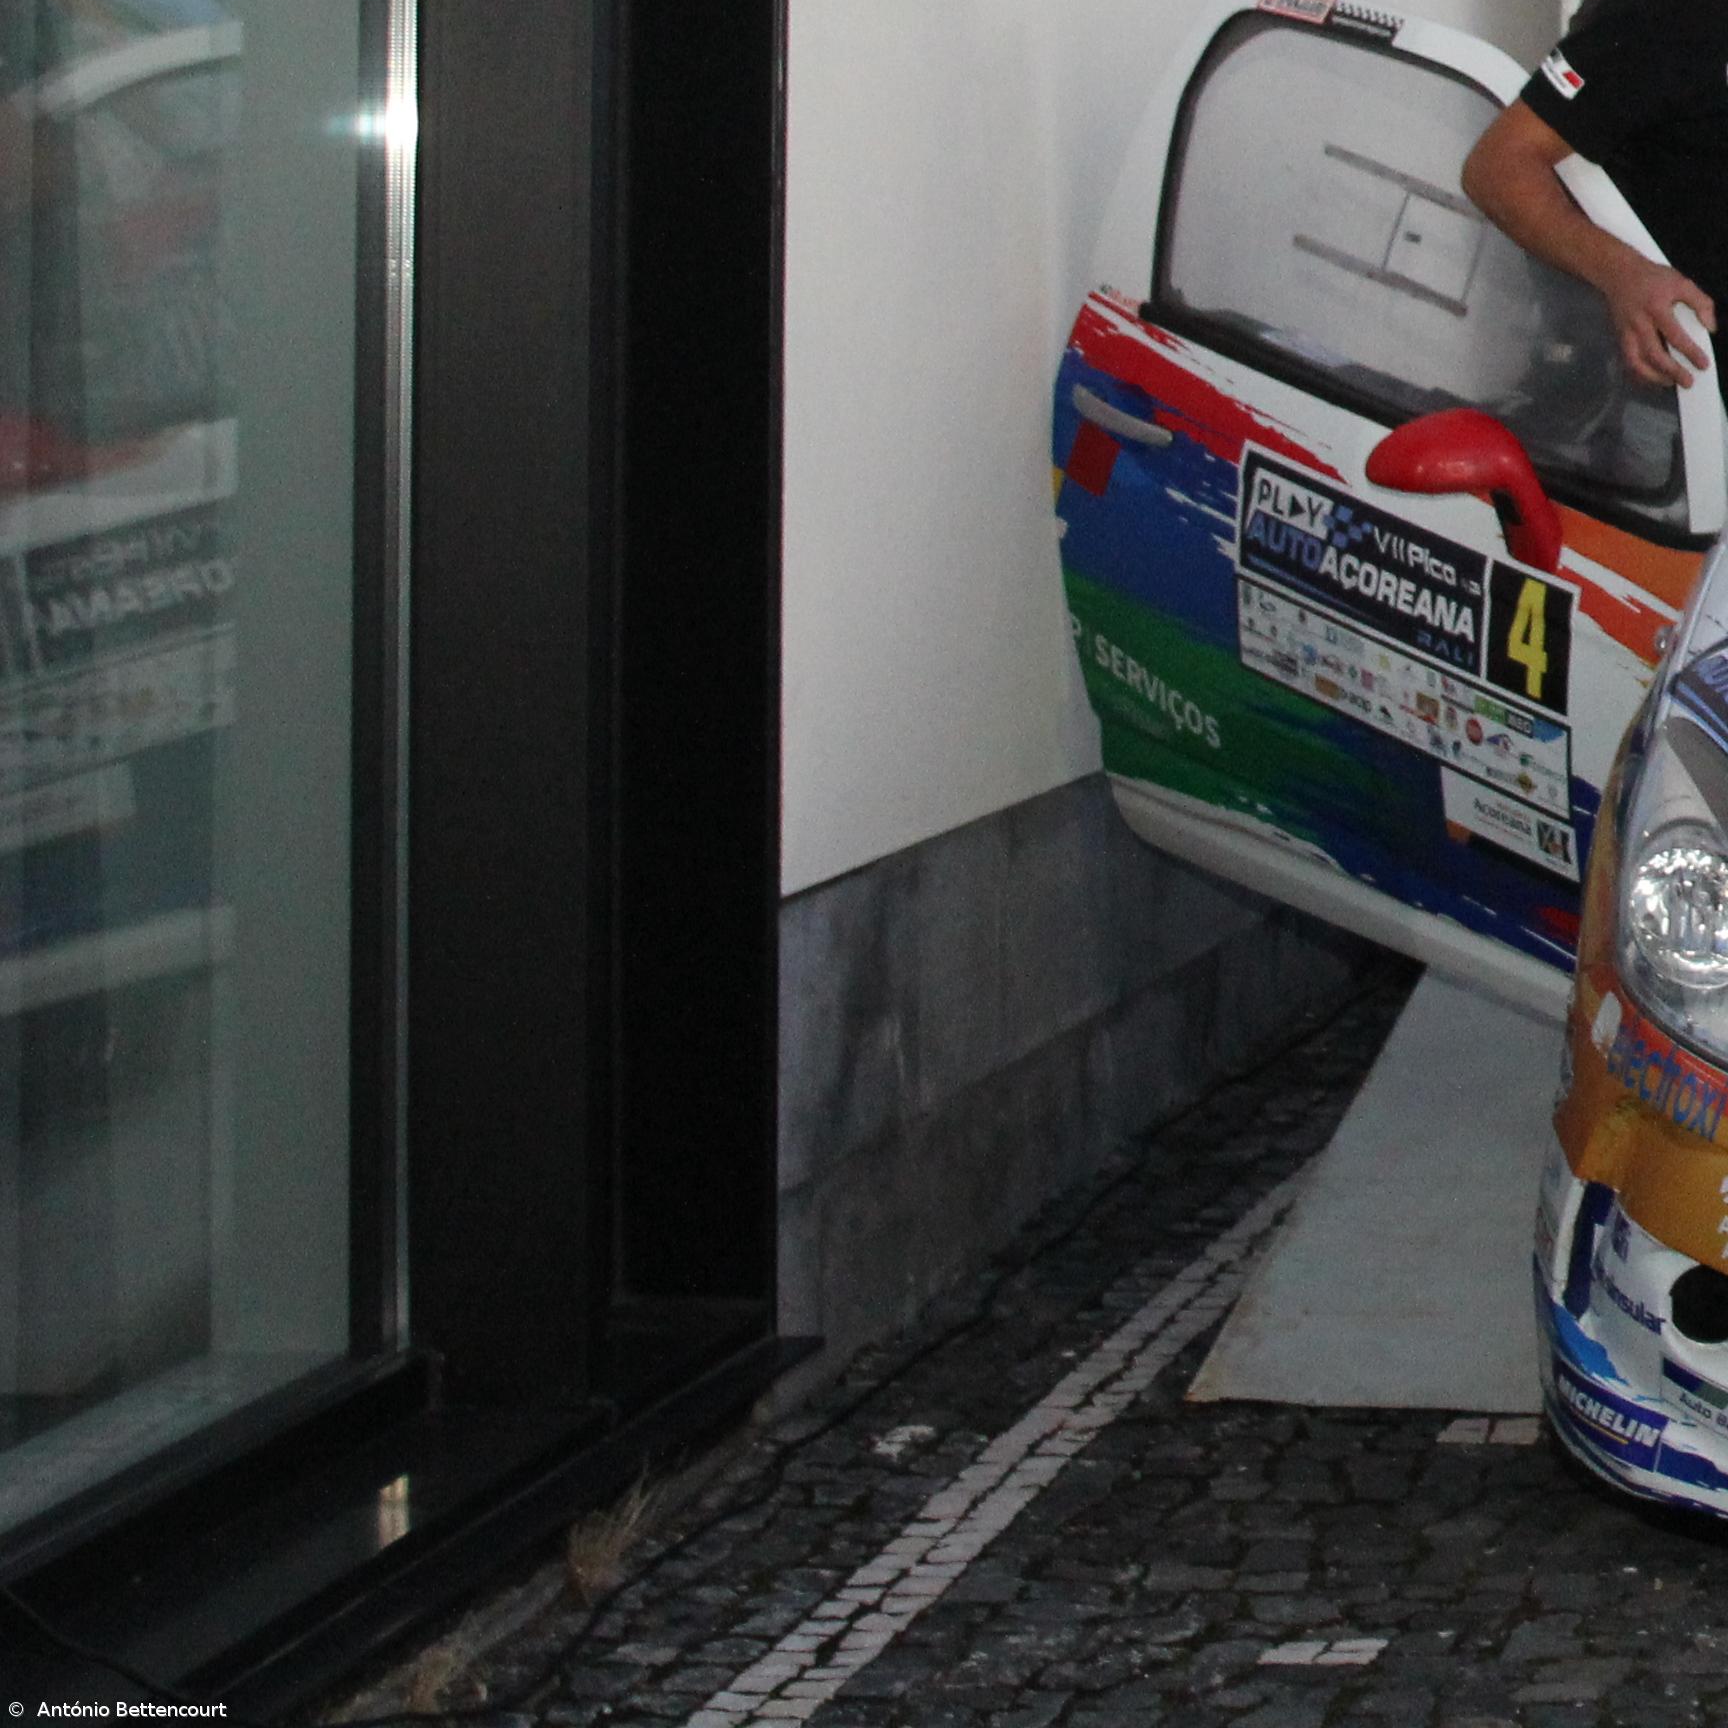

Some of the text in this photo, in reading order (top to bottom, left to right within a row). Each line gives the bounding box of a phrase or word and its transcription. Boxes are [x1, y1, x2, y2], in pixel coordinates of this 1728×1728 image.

[1507, 577, 1548, 700] 4
[1095, 634, 1222, 749] SERVIÇOS
[1557, 1373, 1662, 1448] MICHELIN
[1679, 1393, 1712, 1419] Auto
